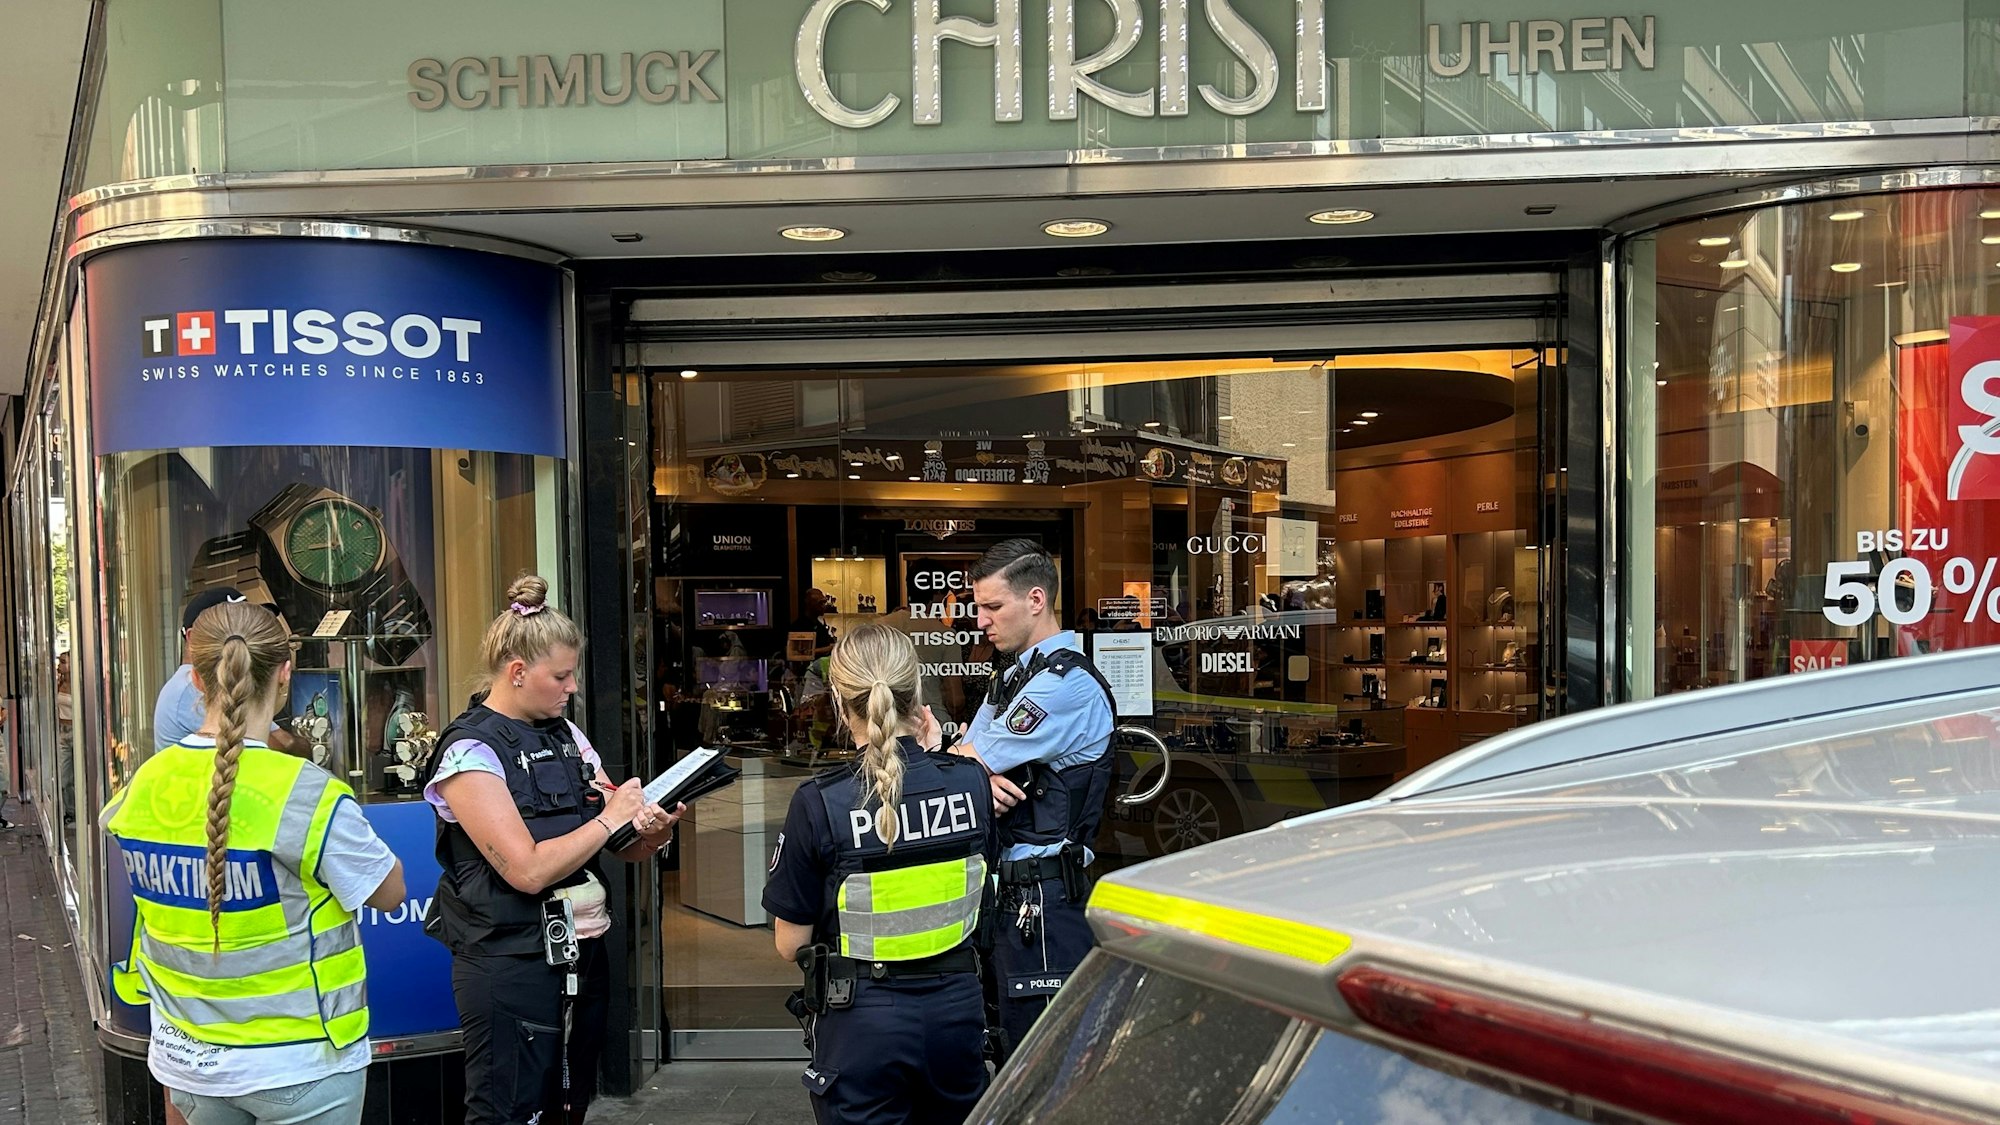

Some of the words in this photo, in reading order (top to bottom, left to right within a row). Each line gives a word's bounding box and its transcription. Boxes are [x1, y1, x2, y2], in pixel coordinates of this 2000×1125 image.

[1426, 14, 1656, 77] UHREN
[407, 49, 721, 111] SCHMUCK
[224, 309, 482, 362] TISSOT
[142, 366, 200, 381] SWISS
[214, 363, 328, 377] WATCHES
[345, 365, 419, 380] SINCE
[436, 370, 484, 385] 1853
[1476, 501, 1499, 512] PERLE
[904, 518, 976, 531] LONGINES
[713, 535, 751, 544] UNION
[1186, 535, 1265, 554] GUCCI
[1857, 529, 1903, 553] BIS
[1911, 528, 1949, 551] ZU
[914, 571, 974, 590] EBEL
[910, 631, 984, 646] TISSOT
[1156, 626, 1221, 641] EMPORIO
[1239, 623, 1300, 640] ARMANI
[1201, 652, 1254, 673] DIESEL
[1021, 700, 1043, 719] POLIZEI
[1030, 979, 1062, 989] POLIZEI
